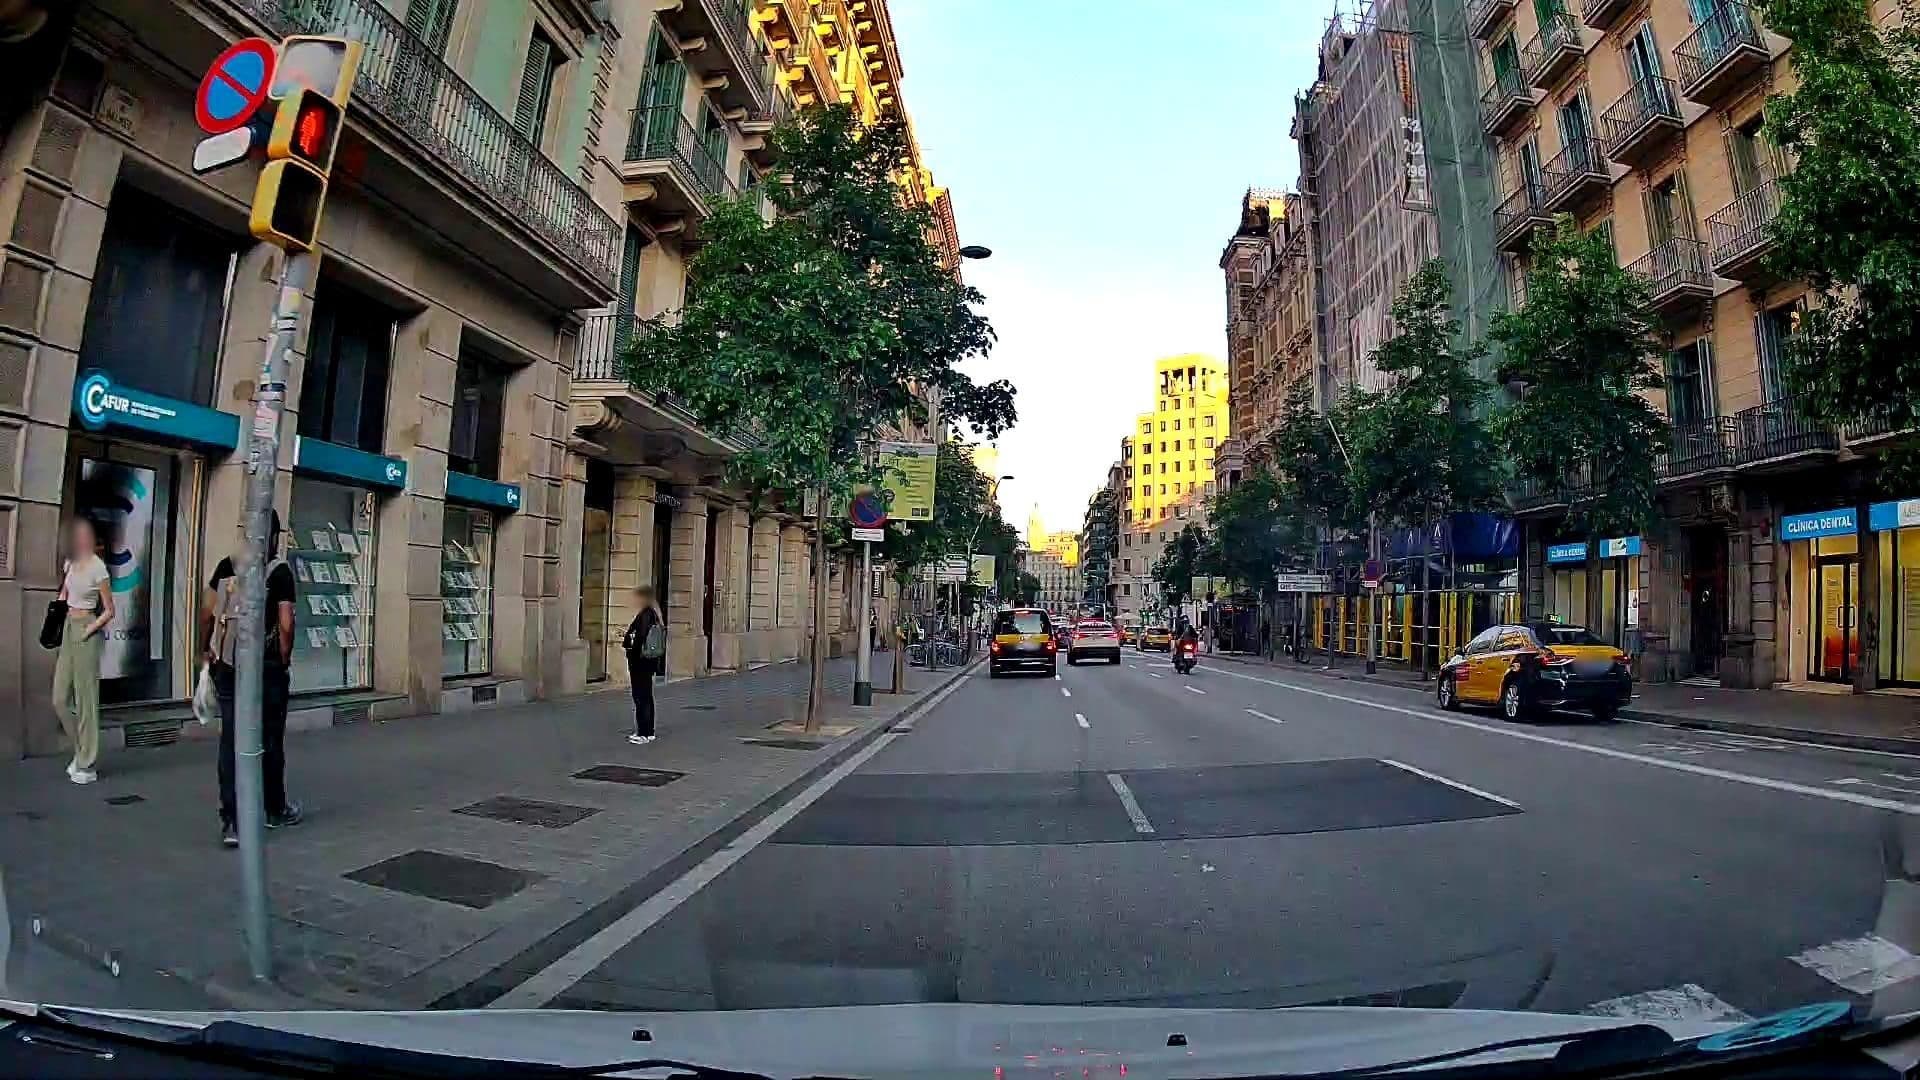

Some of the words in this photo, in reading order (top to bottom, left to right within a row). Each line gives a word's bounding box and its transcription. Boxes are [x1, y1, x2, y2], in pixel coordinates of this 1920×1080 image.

[87, 384, 130, 413] CAFUR
[1788, 519, 1819, 533] CLÍNICA
[1820, 515, 1853, 529] DENTAL
